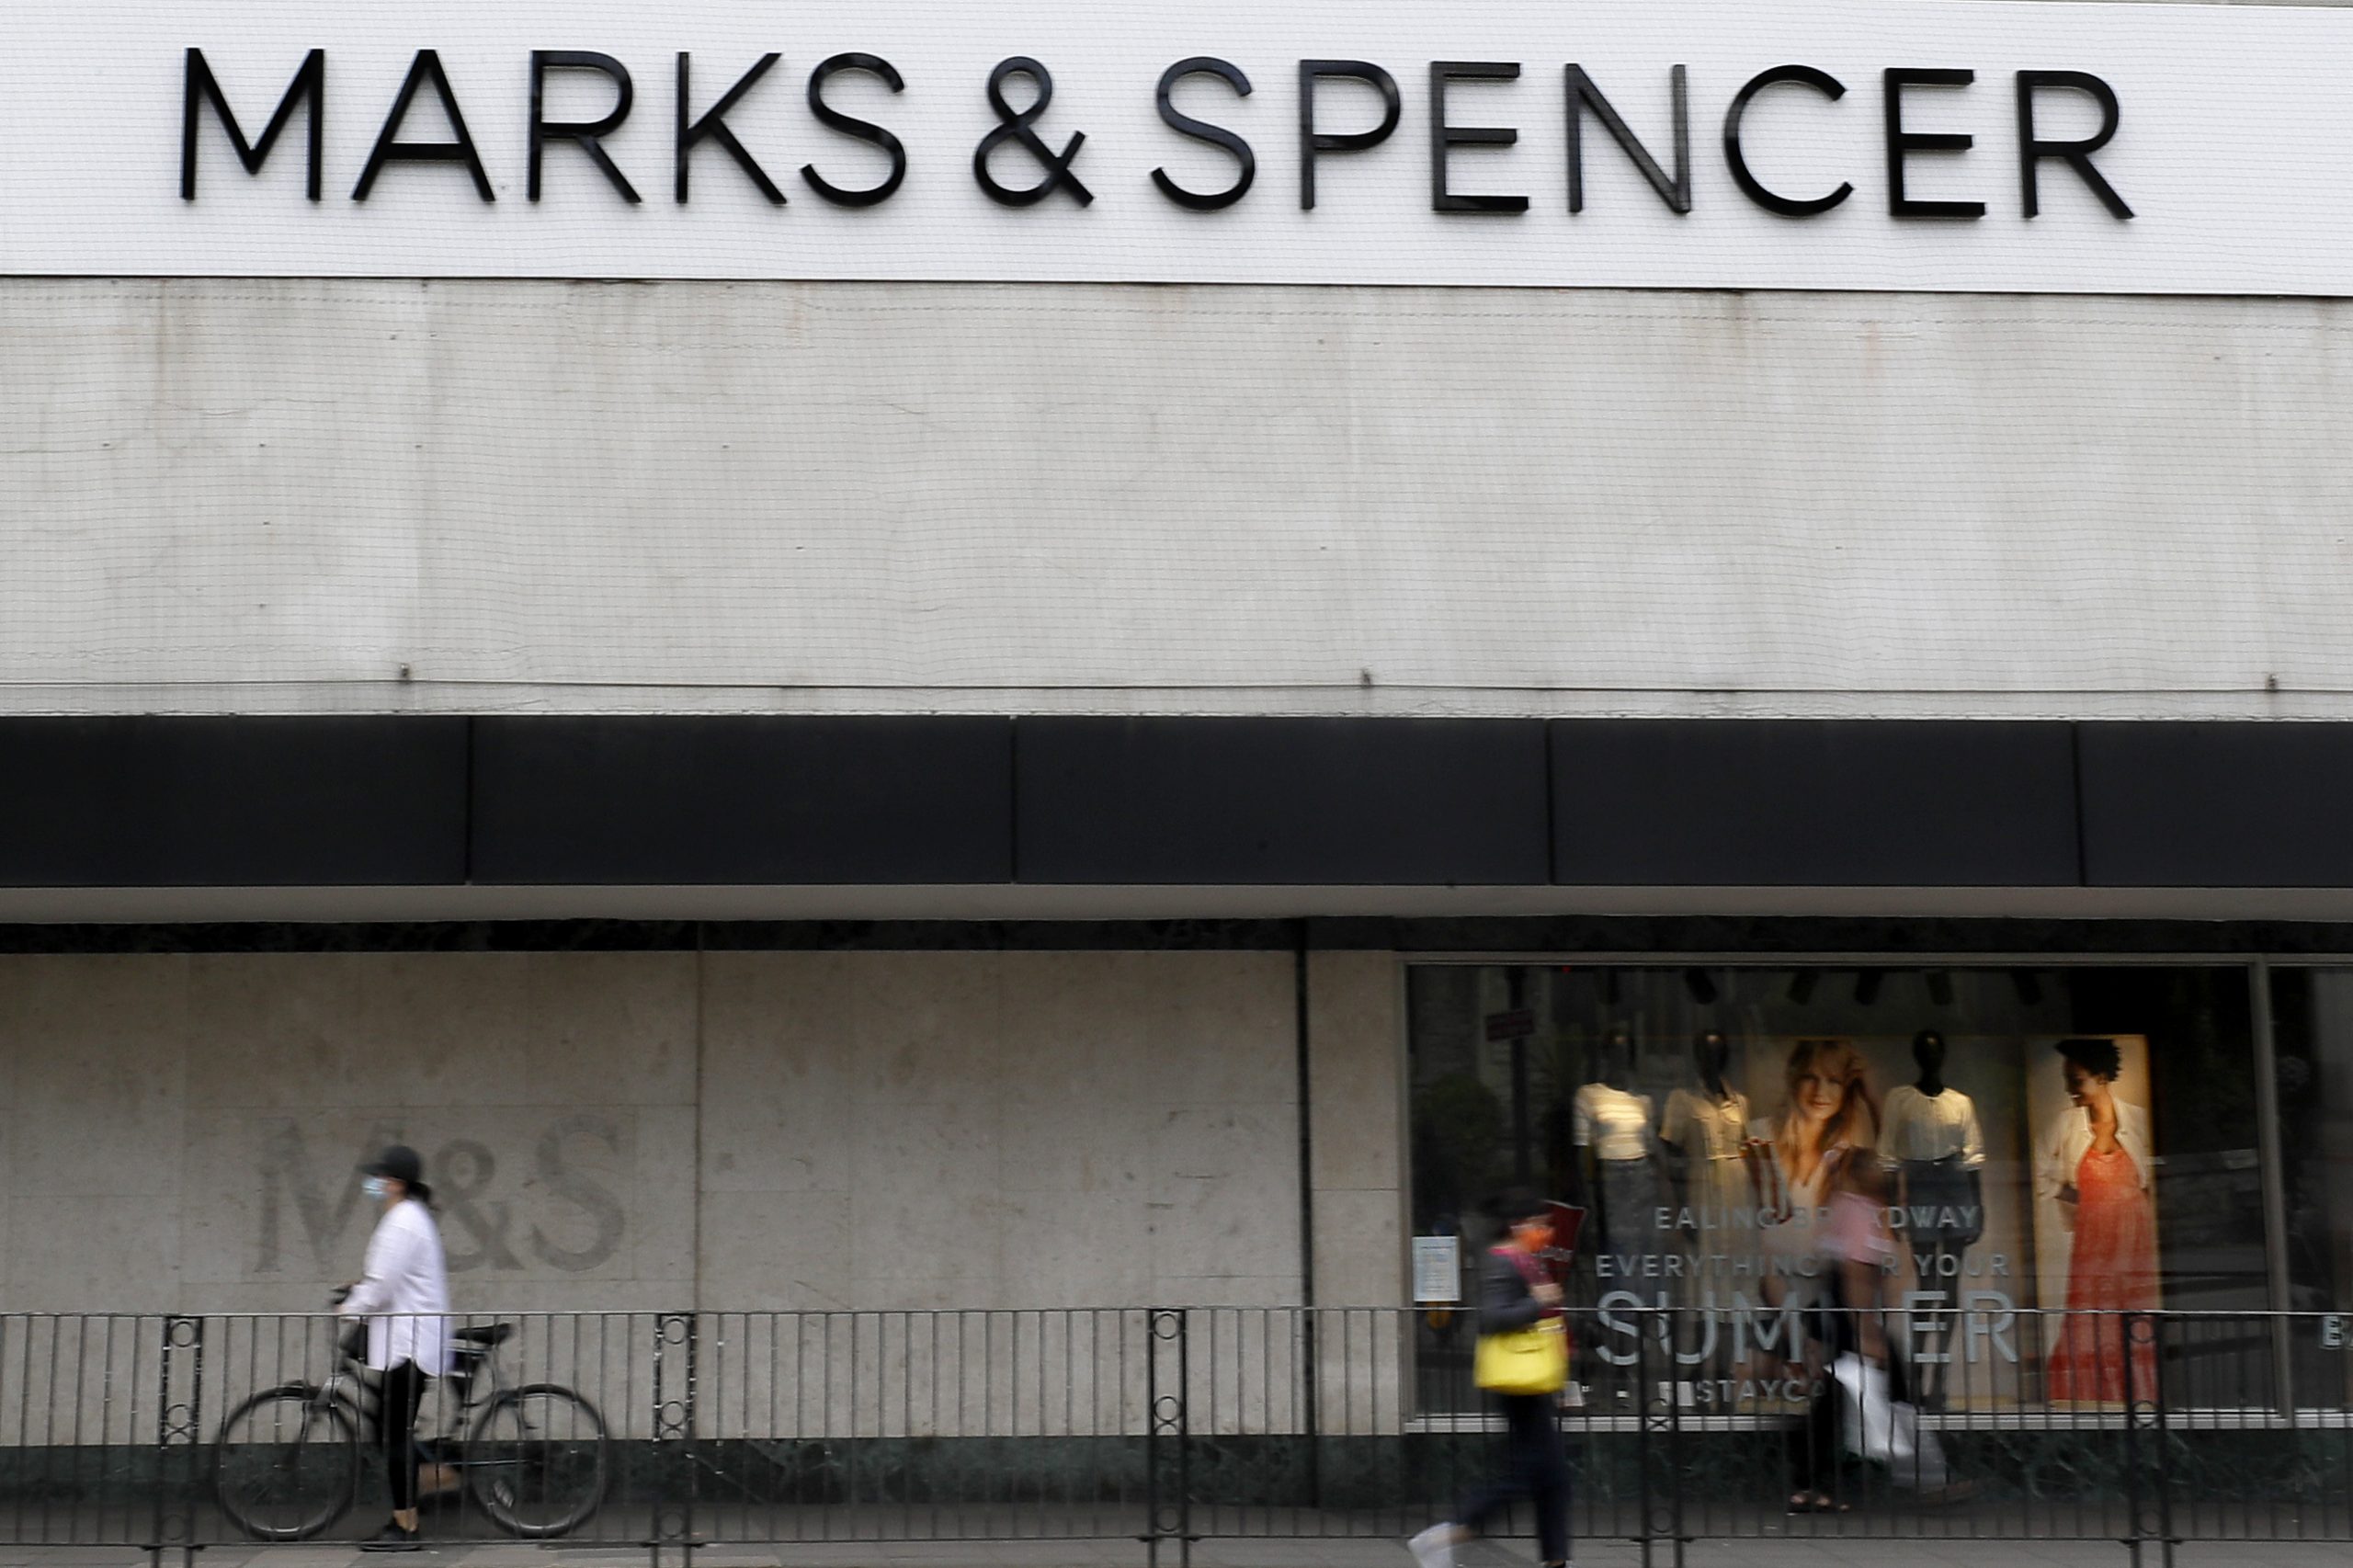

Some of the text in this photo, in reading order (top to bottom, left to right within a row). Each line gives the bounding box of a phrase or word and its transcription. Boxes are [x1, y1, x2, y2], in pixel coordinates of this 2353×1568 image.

[180, 47, 2135, 222] MARKS & SPENCER
[254, 1113, 625, 1274] M&S
[1655, 1206, 1778, 1230] EALING
[1913, 1254, 2010, 1278] YOUR
[1596, 1290, 2019, 1366] SUMER
